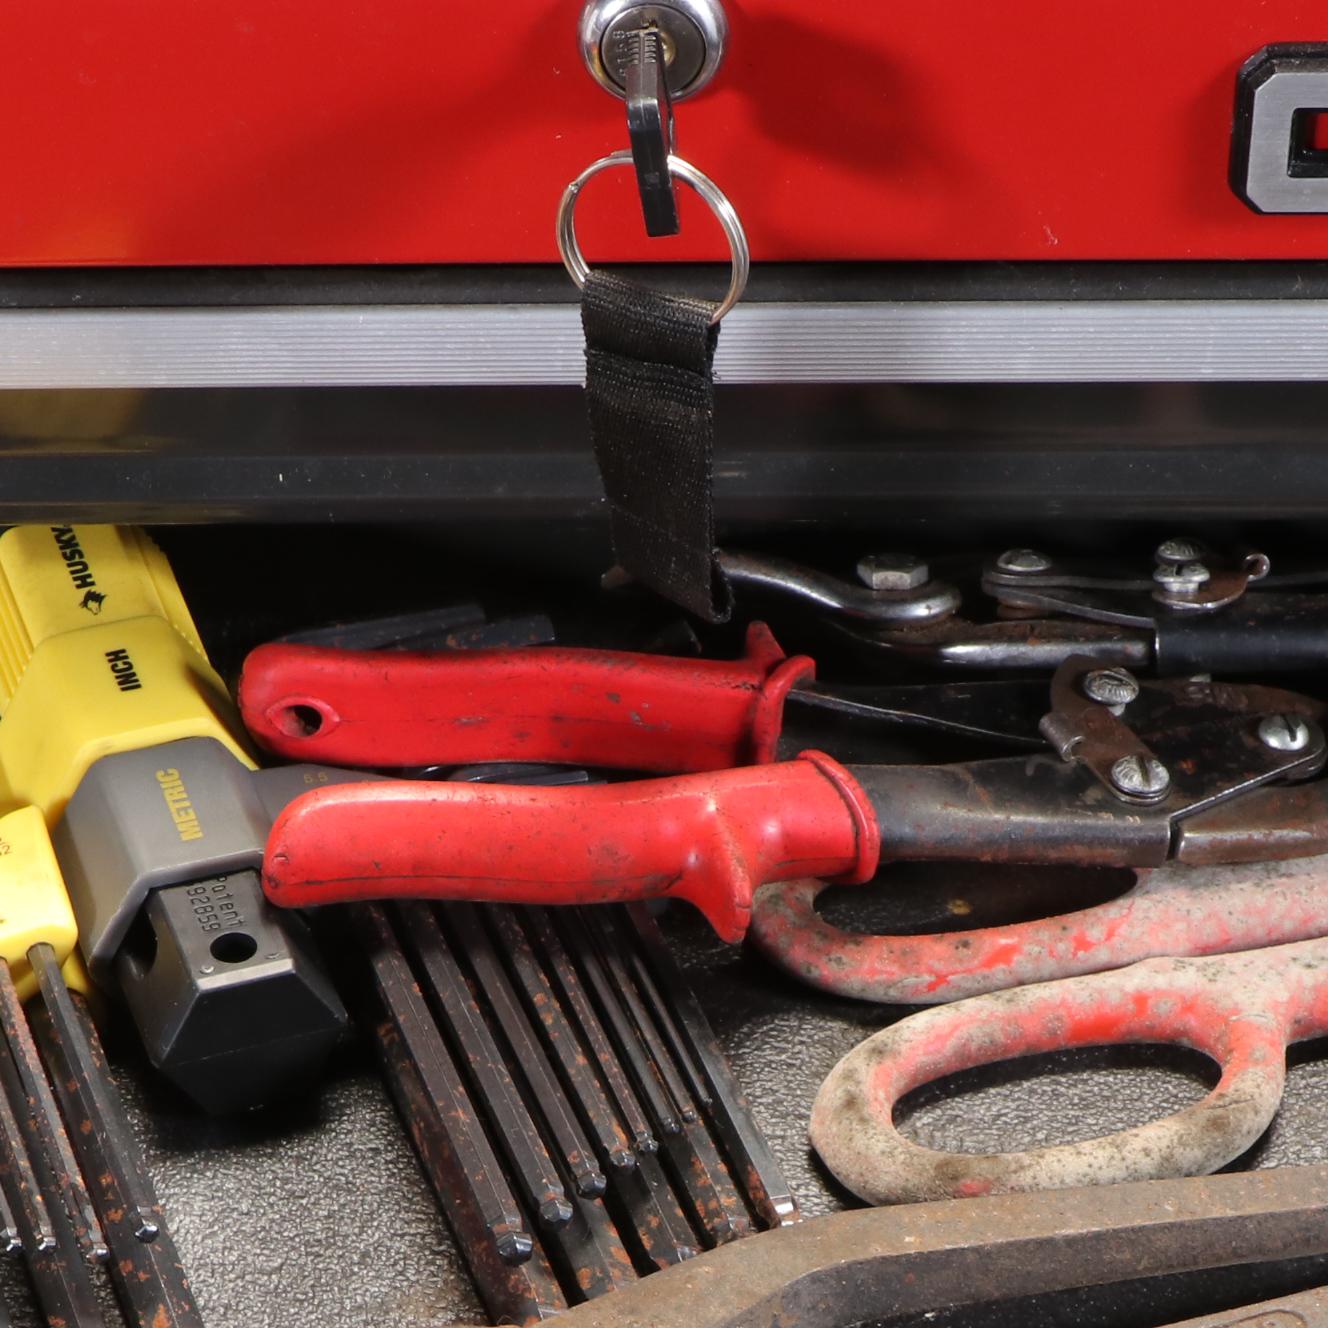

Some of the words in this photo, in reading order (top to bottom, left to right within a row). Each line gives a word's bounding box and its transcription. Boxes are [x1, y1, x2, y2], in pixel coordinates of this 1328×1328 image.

[50, 526, 96, 590] HUSKY
[105, 648, 142, 692] INCH
[155, 768, 204, 841] METRIC
